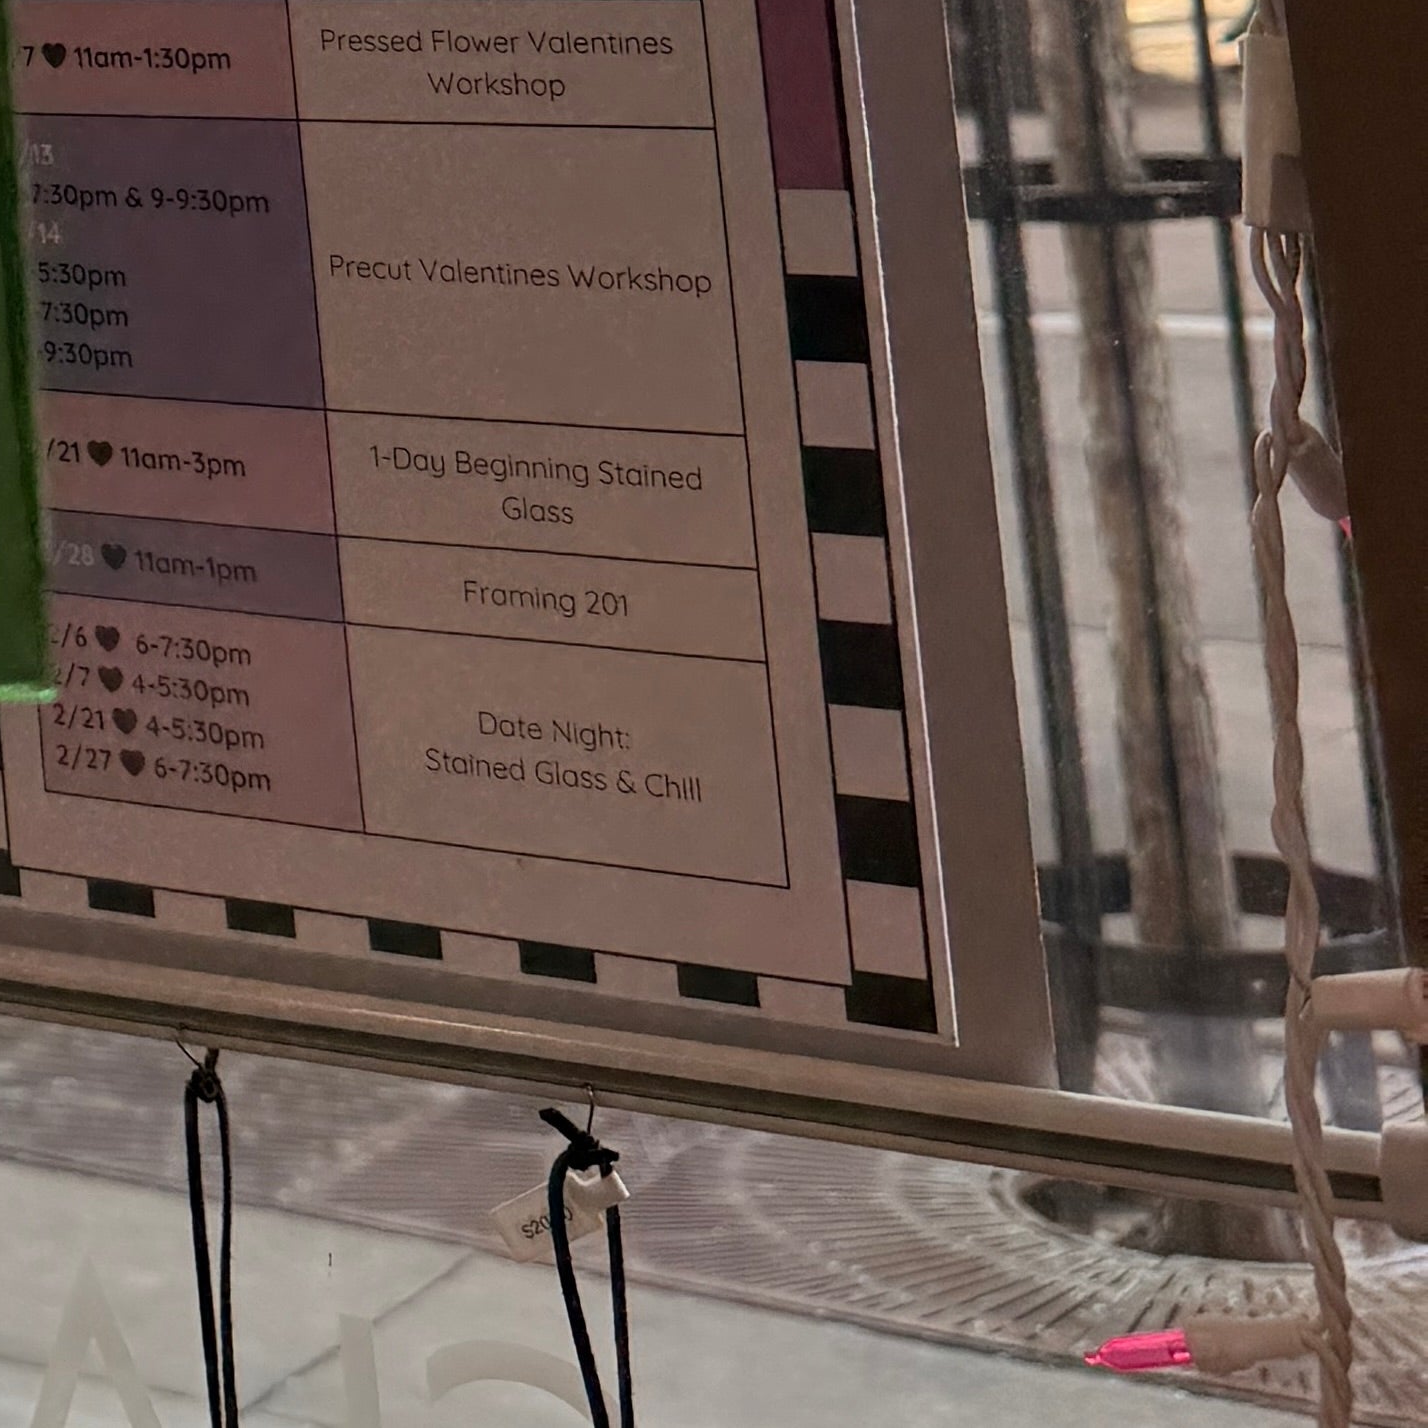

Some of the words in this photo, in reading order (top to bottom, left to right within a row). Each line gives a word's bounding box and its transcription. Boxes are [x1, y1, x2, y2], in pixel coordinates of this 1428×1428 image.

[73, 45, 232, 75] 11am-1:30pm
[320, 28, 423, 53] Pressed
[431, 29, 520, 55] Flower
[528, 30, 674, 56] Valentines
[427, 71, 566, 103] Workshop
[125, 187, 143, 209] &
[150, 187, 270, 219] 9-9:30pm
[329, 254, 411, 282] Precut
[418, 258, 560, 288] Valentines
[567, 264, 712, 298] Workshop
[120, 446, 246, 479] 11am-3pm
[369, 444, 446, 479] 1-Day
[454, 450, 590, 489] Beginning
[598, 461, 703, 491] Stained
[501, 497, 575, 525] Glass
[134, 549, 257, 585] 11am-1pm
[464, 580, 576, 618] Framing
[585, 590, 629, 617] 201
[135, 633, 251, 668] 6-7:30pm
[132, 675, 251, 711] 4-5:30pm
[53, 702, 105, 731] 2/21
[145, 714, 265, 751] 4-5:30pm
[478, 710, 543, 740] Date
[553, 719, 631, 753] Night:
[56, 743, 111, 771] 2/27
[153, 758, 271, 793] 6-7:30pm
[425, 748, 526, 782] Stained
[535, 760, 607, 792] Glass
[616, 770, 638, 795] &
[644, 774, 703, 804] Chill
